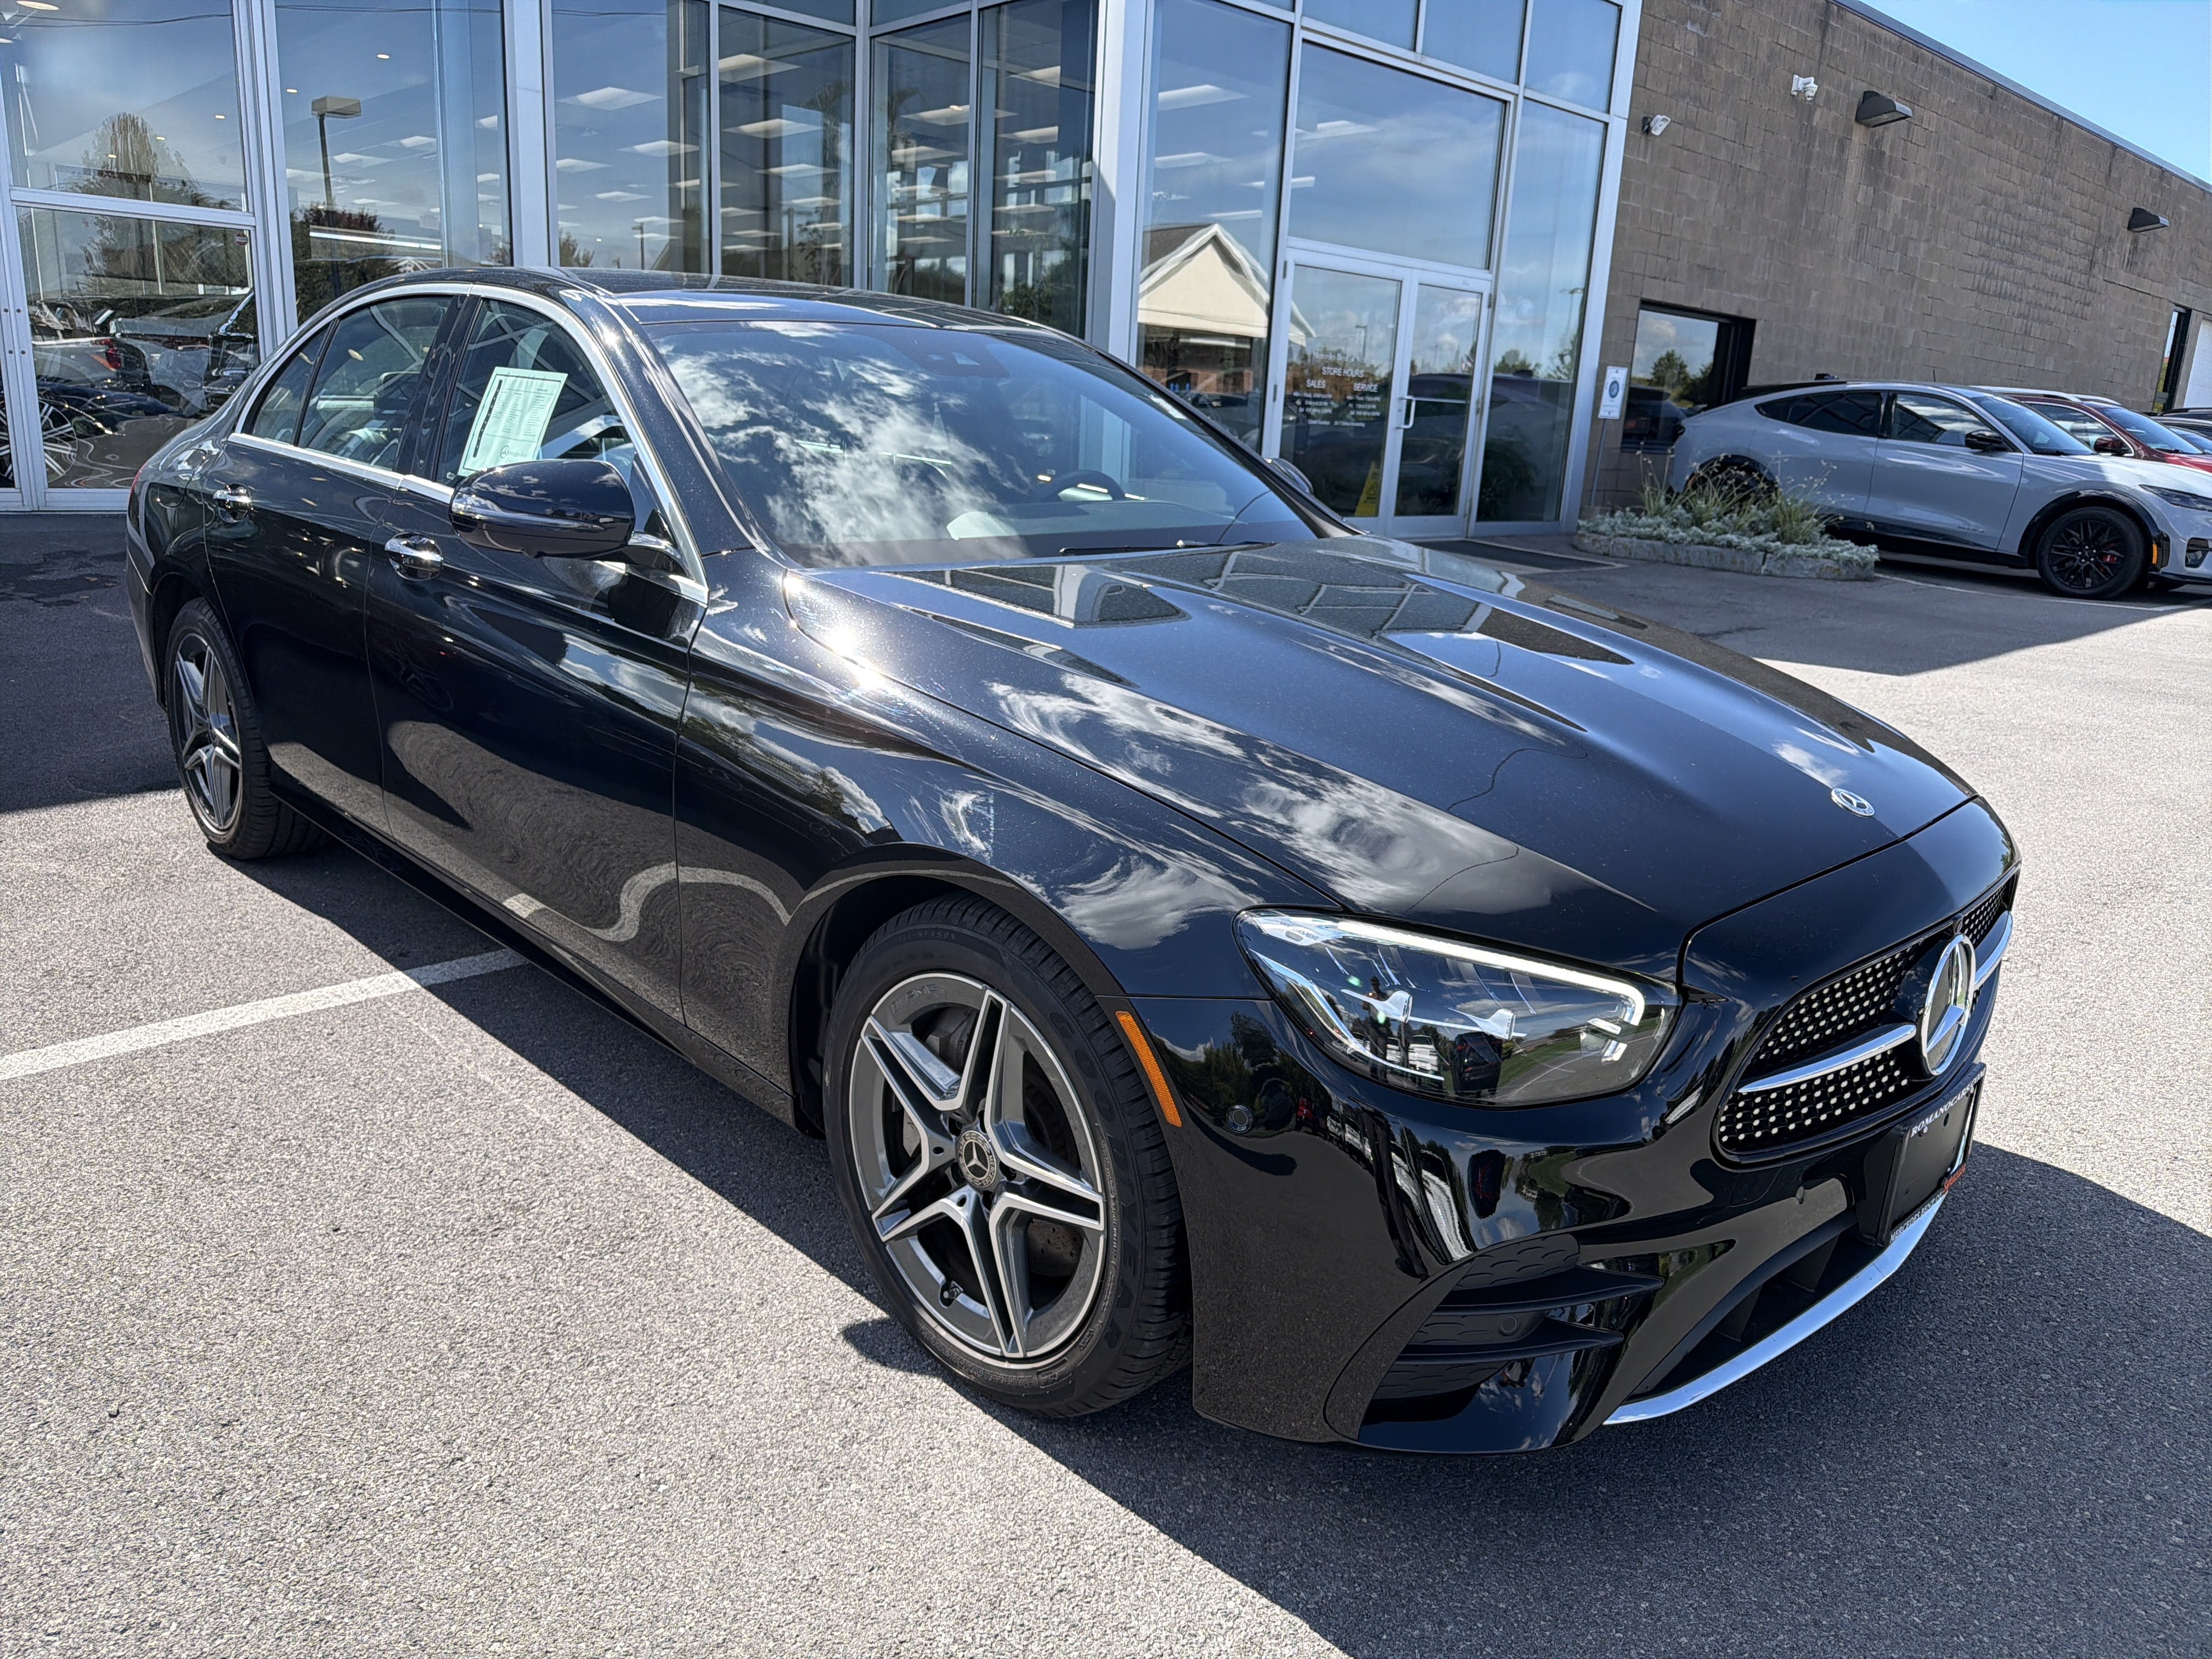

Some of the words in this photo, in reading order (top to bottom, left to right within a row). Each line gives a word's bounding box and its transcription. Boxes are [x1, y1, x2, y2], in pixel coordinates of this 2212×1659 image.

[1322, 366, 1342, 376] STORE
[1306, 379, 1326, 388] SALES
[1353, 382, 1379, 393] SERVICE
[899, 931, 956, 941] LL-SEASON
[1910, 1066, 1986, 1138] ROMANOCARS.COM
[981, 1155, 995, 1186] MERCEDES
[1889, 1211, 1921, 1243] MERCEDES
